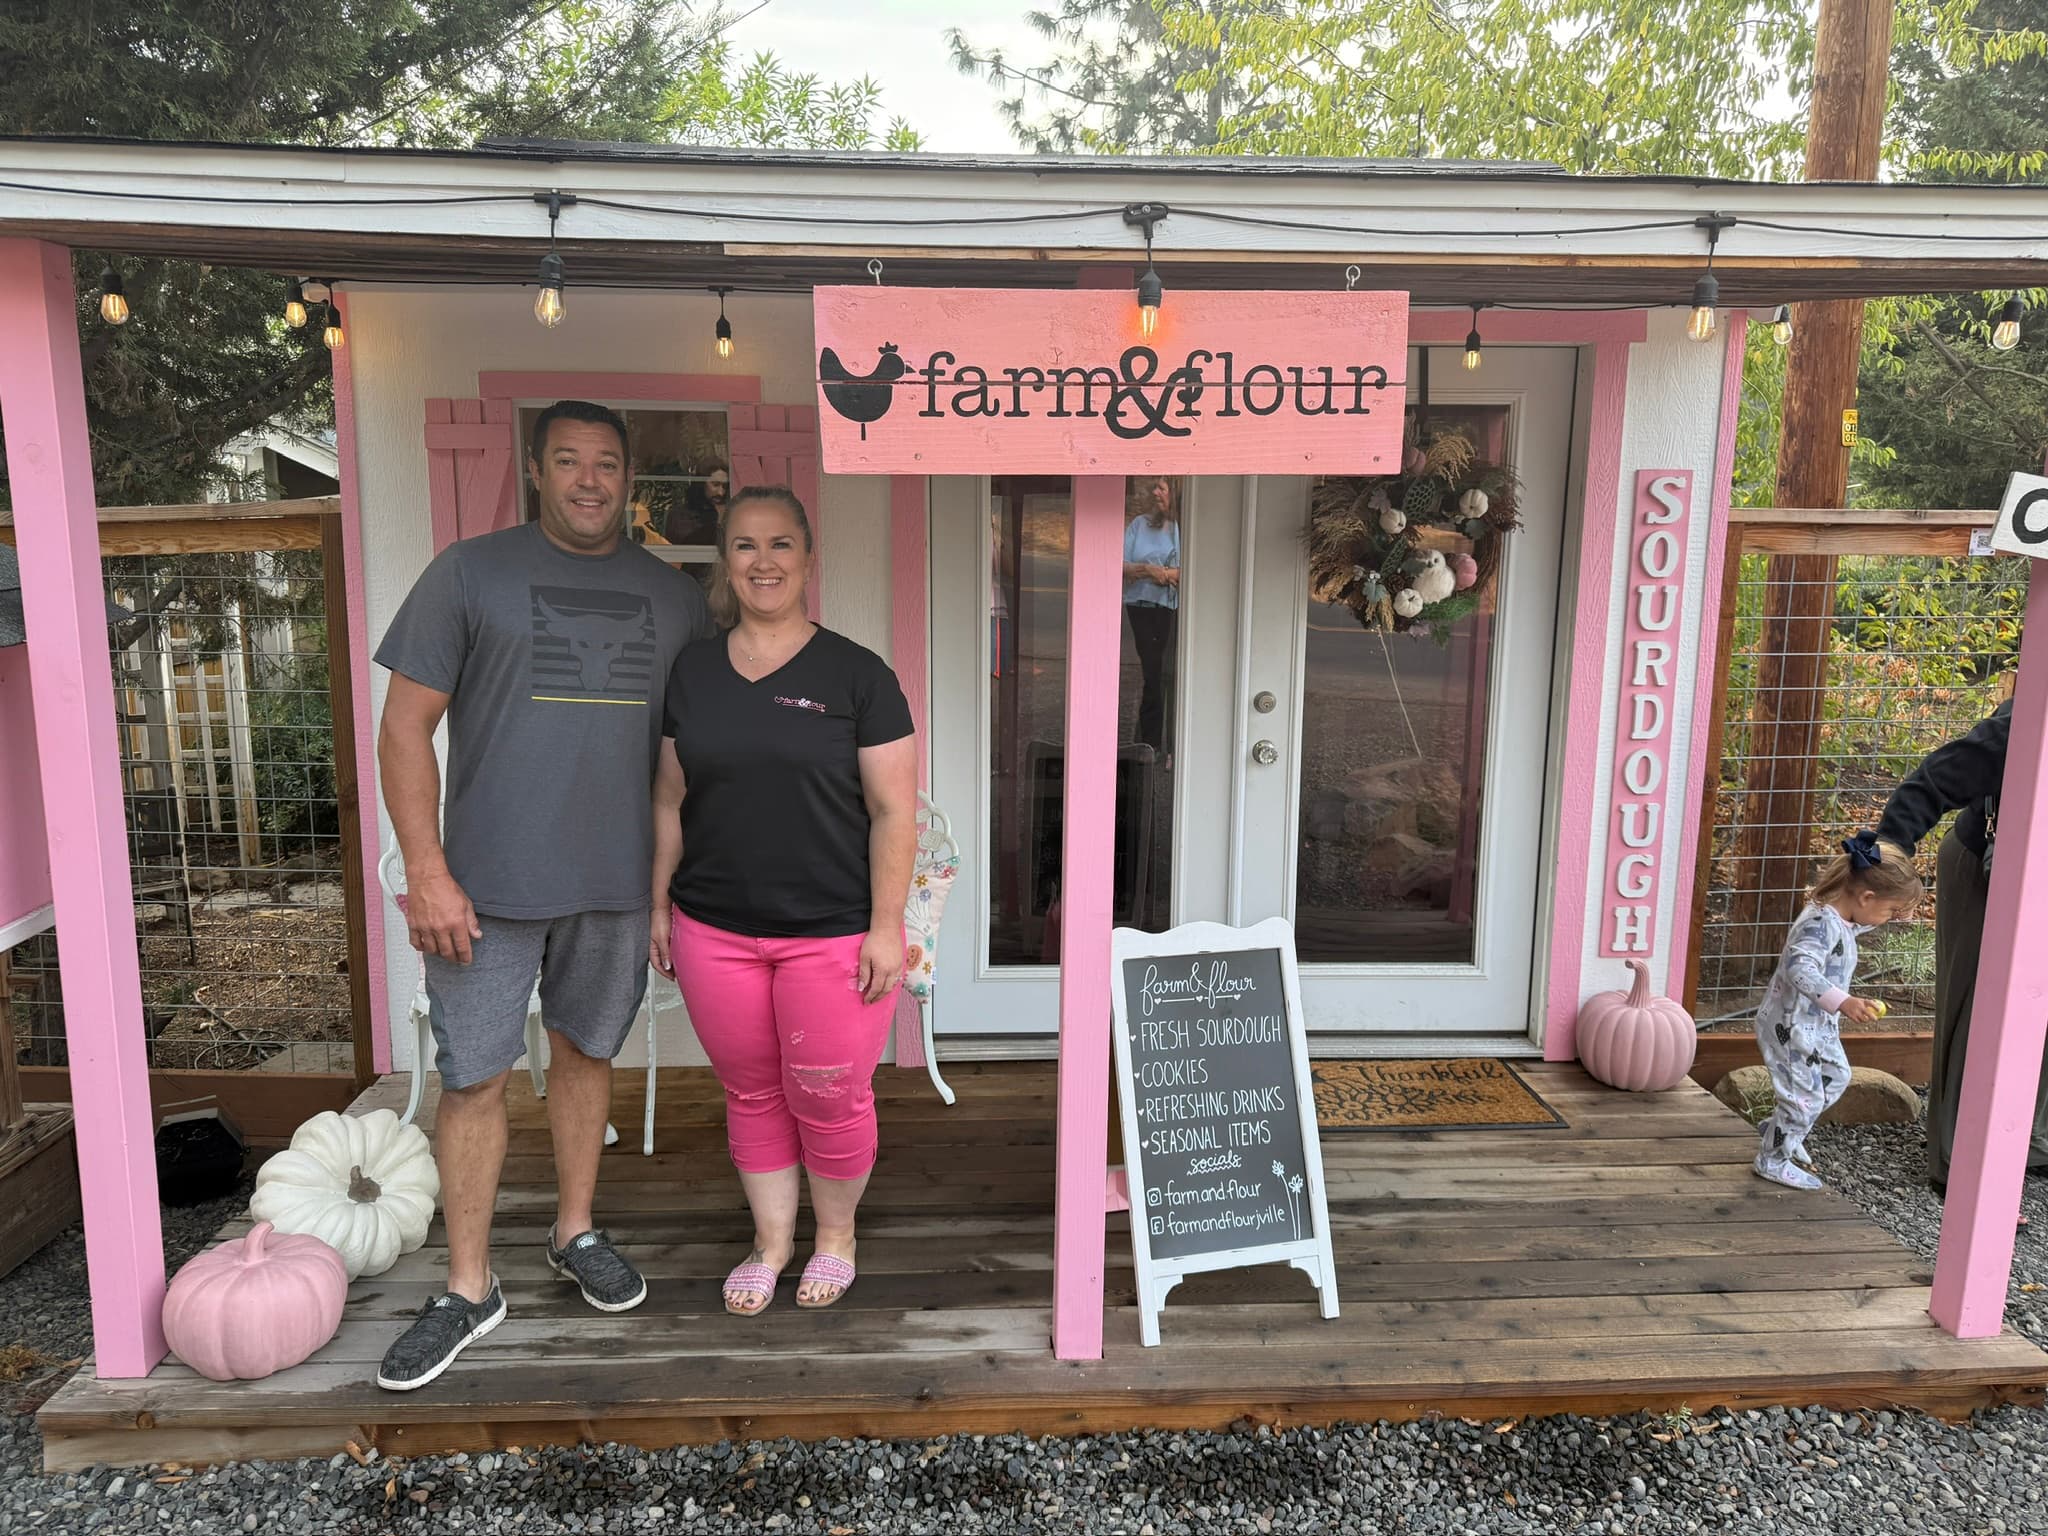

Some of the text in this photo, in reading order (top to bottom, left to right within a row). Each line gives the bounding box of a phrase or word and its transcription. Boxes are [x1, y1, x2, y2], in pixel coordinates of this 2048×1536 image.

[1611, 475, 1688, 953] SOURDOUGH
[1140, 1016, 1282, 1051] FRESH SOURDOUGH
[1141, 1058, 1209, 1088] COOKIES
[1341, 1062, 1504, 1084] Thankful
[1145, 1086, 1286, 1123] REFRESHING DRINKS
[1150, 1120, 1271, 1155] SEASONAL ITEMS
[1190, 1150, 1242, 1171] socials
[1167, 1203, 1286, 1236] farmandflourjville
